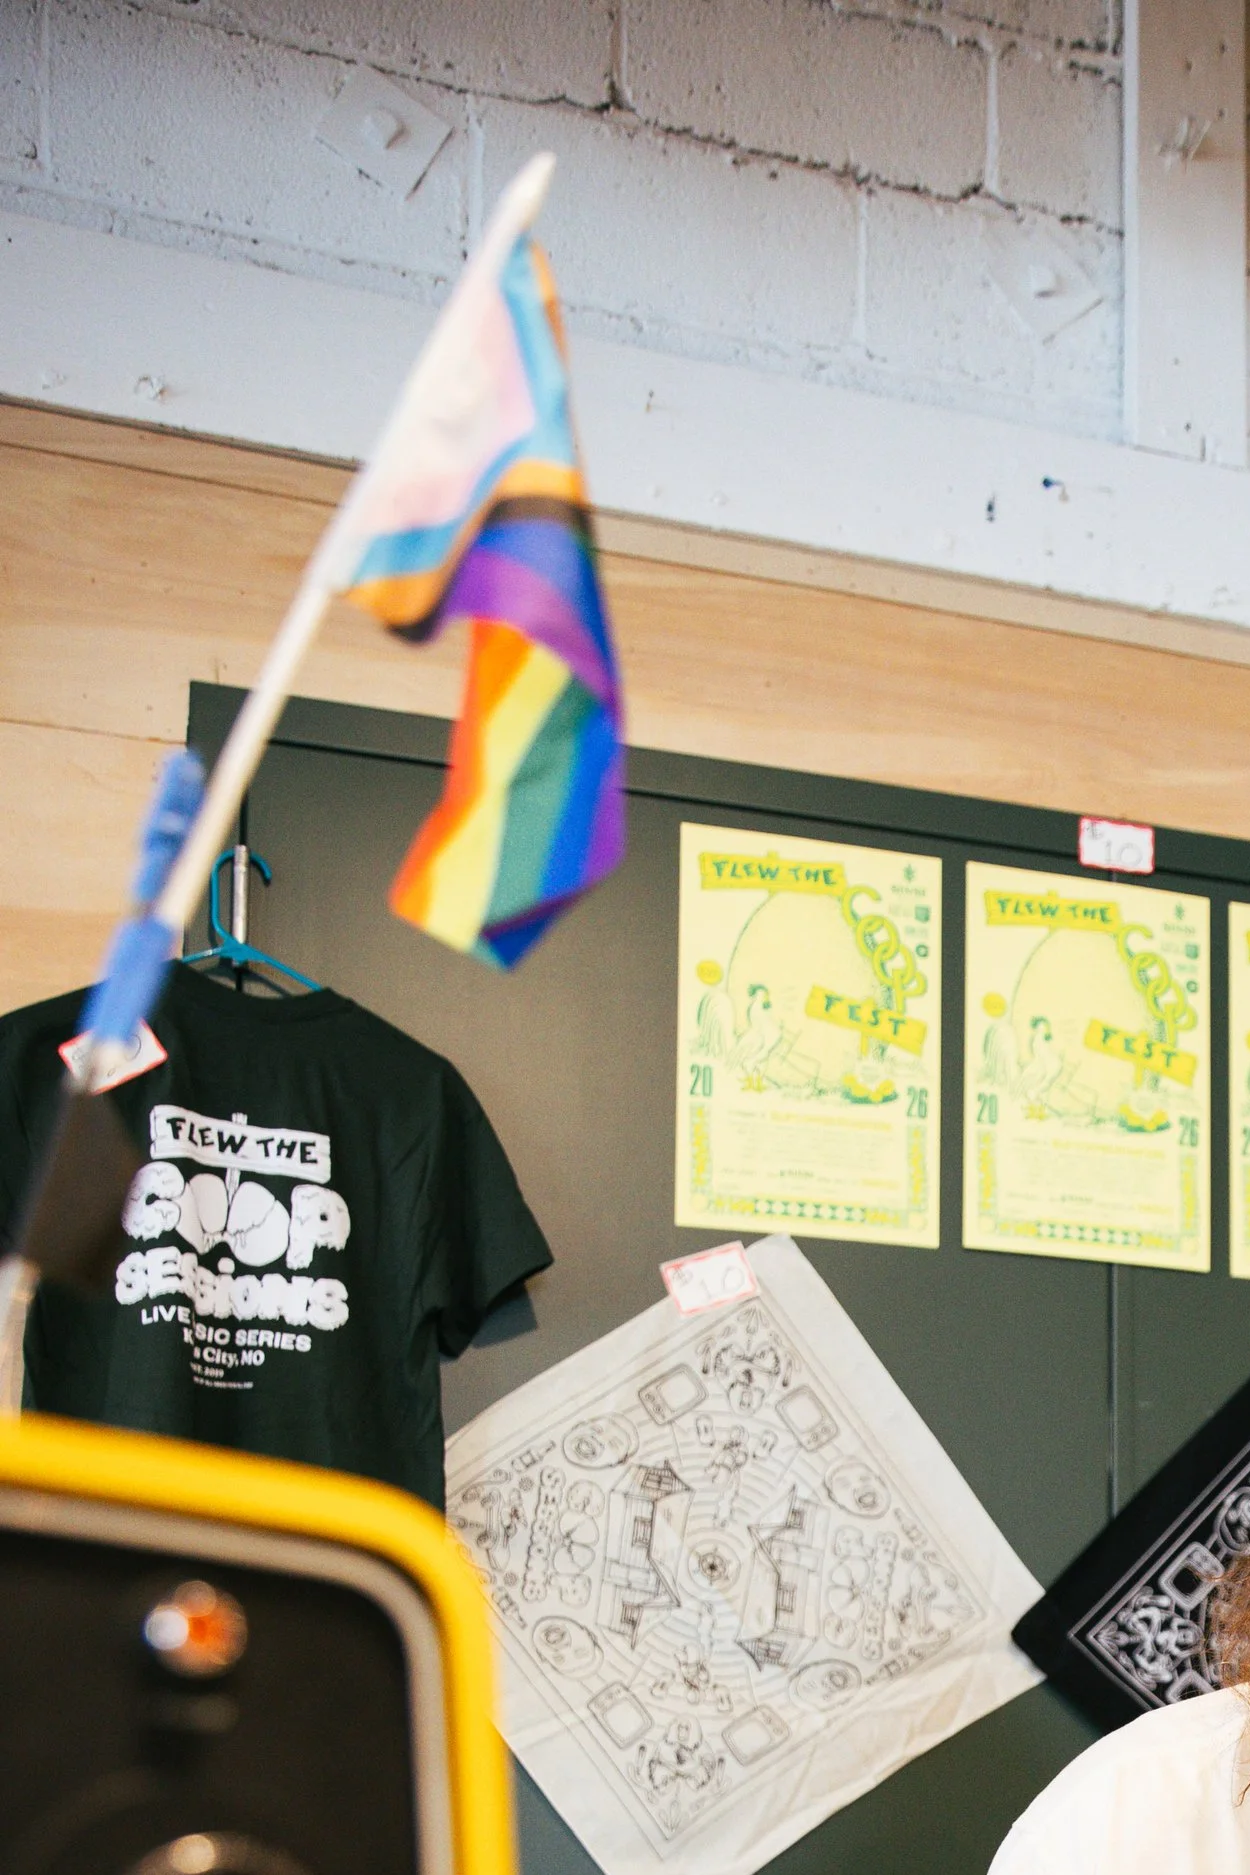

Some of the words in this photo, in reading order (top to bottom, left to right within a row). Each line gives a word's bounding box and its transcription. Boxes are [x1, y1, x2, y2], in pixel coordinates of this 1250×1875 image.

[712, 859, 780, 881] FLEW
[788, 866, 838, 886] THE
[997, 899, 1058, 919] FLEW
[1066, 904, 1113, 924] THE
[823, 994, 907, 1039] FEST
[1100, 1027, 1178, 1068] FEST
[690, 1063, 713, 1097] 20
[907, 1085, 929, 1120] 26
[977, 1092, 999, 1124] 20
[166, 1117, 247, 1154] FLEW
[256, 1138, 318, 1164] THE
[1179, 1116, 1199, 1148] 26
[141, 1304, 191, 1326] LIVE
[235, 1328, 312, 1352] SERIES
[241, 1347, 266, 1367] MO
